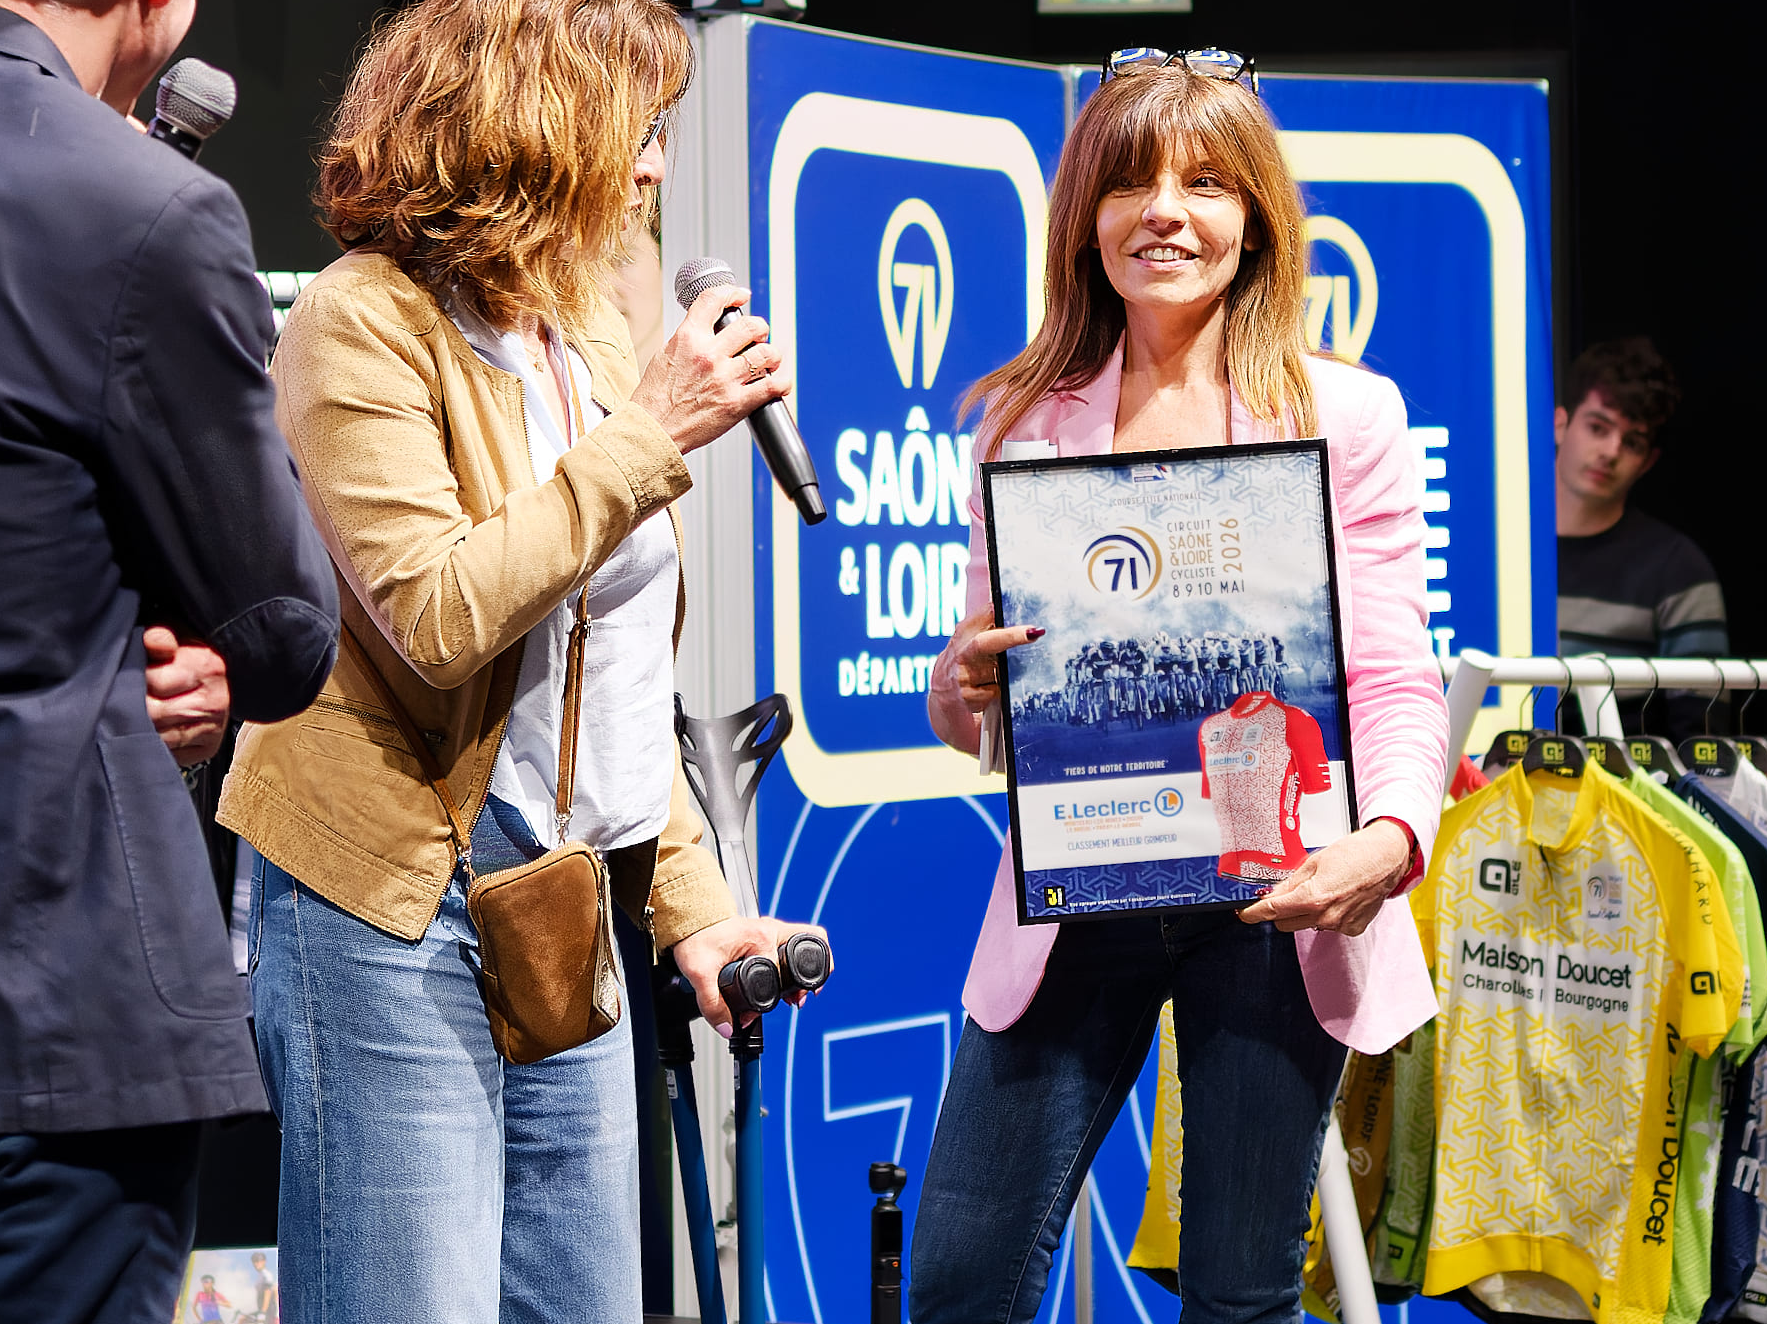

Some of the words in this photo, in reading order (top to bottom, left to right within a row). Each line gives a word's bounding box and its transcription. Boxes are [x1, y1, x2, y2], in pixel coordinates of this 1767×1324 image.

[835, 406, 973, 528] SAÔN
[1167, 519, 1211, 533] CIRCUIT
[1168, 531, 1213, 550] SAÔNE
[1219, 517, 1243, 573] 2026
[1182, 549, 1214, 566] LOIRE
[1104, 557, 1138, 592] 71
[1171, 567, 1216, 580] CYCLISTE
[839, 546, 860, 596] &
[865, 542, 966, 640] LOIR
[1220, 579, 1245, 594] MAI
[838, 651, 934, 698] DÉPART
[1088, 765, 1097, 775] DE
[1100, 763, 1123, 773] NOTRE
[1054, 799, 1151, 820] E.Leclerc
[1067, 838, 1110, 851] CLASSEMENT
[1462, 940, 1544, 978] Maison
[1557, 955, 1631, 989] Doucet
[1555, 988, 1629, 1013] Bourgogne
[1642, 1137, 1679, 1247] Doucet
